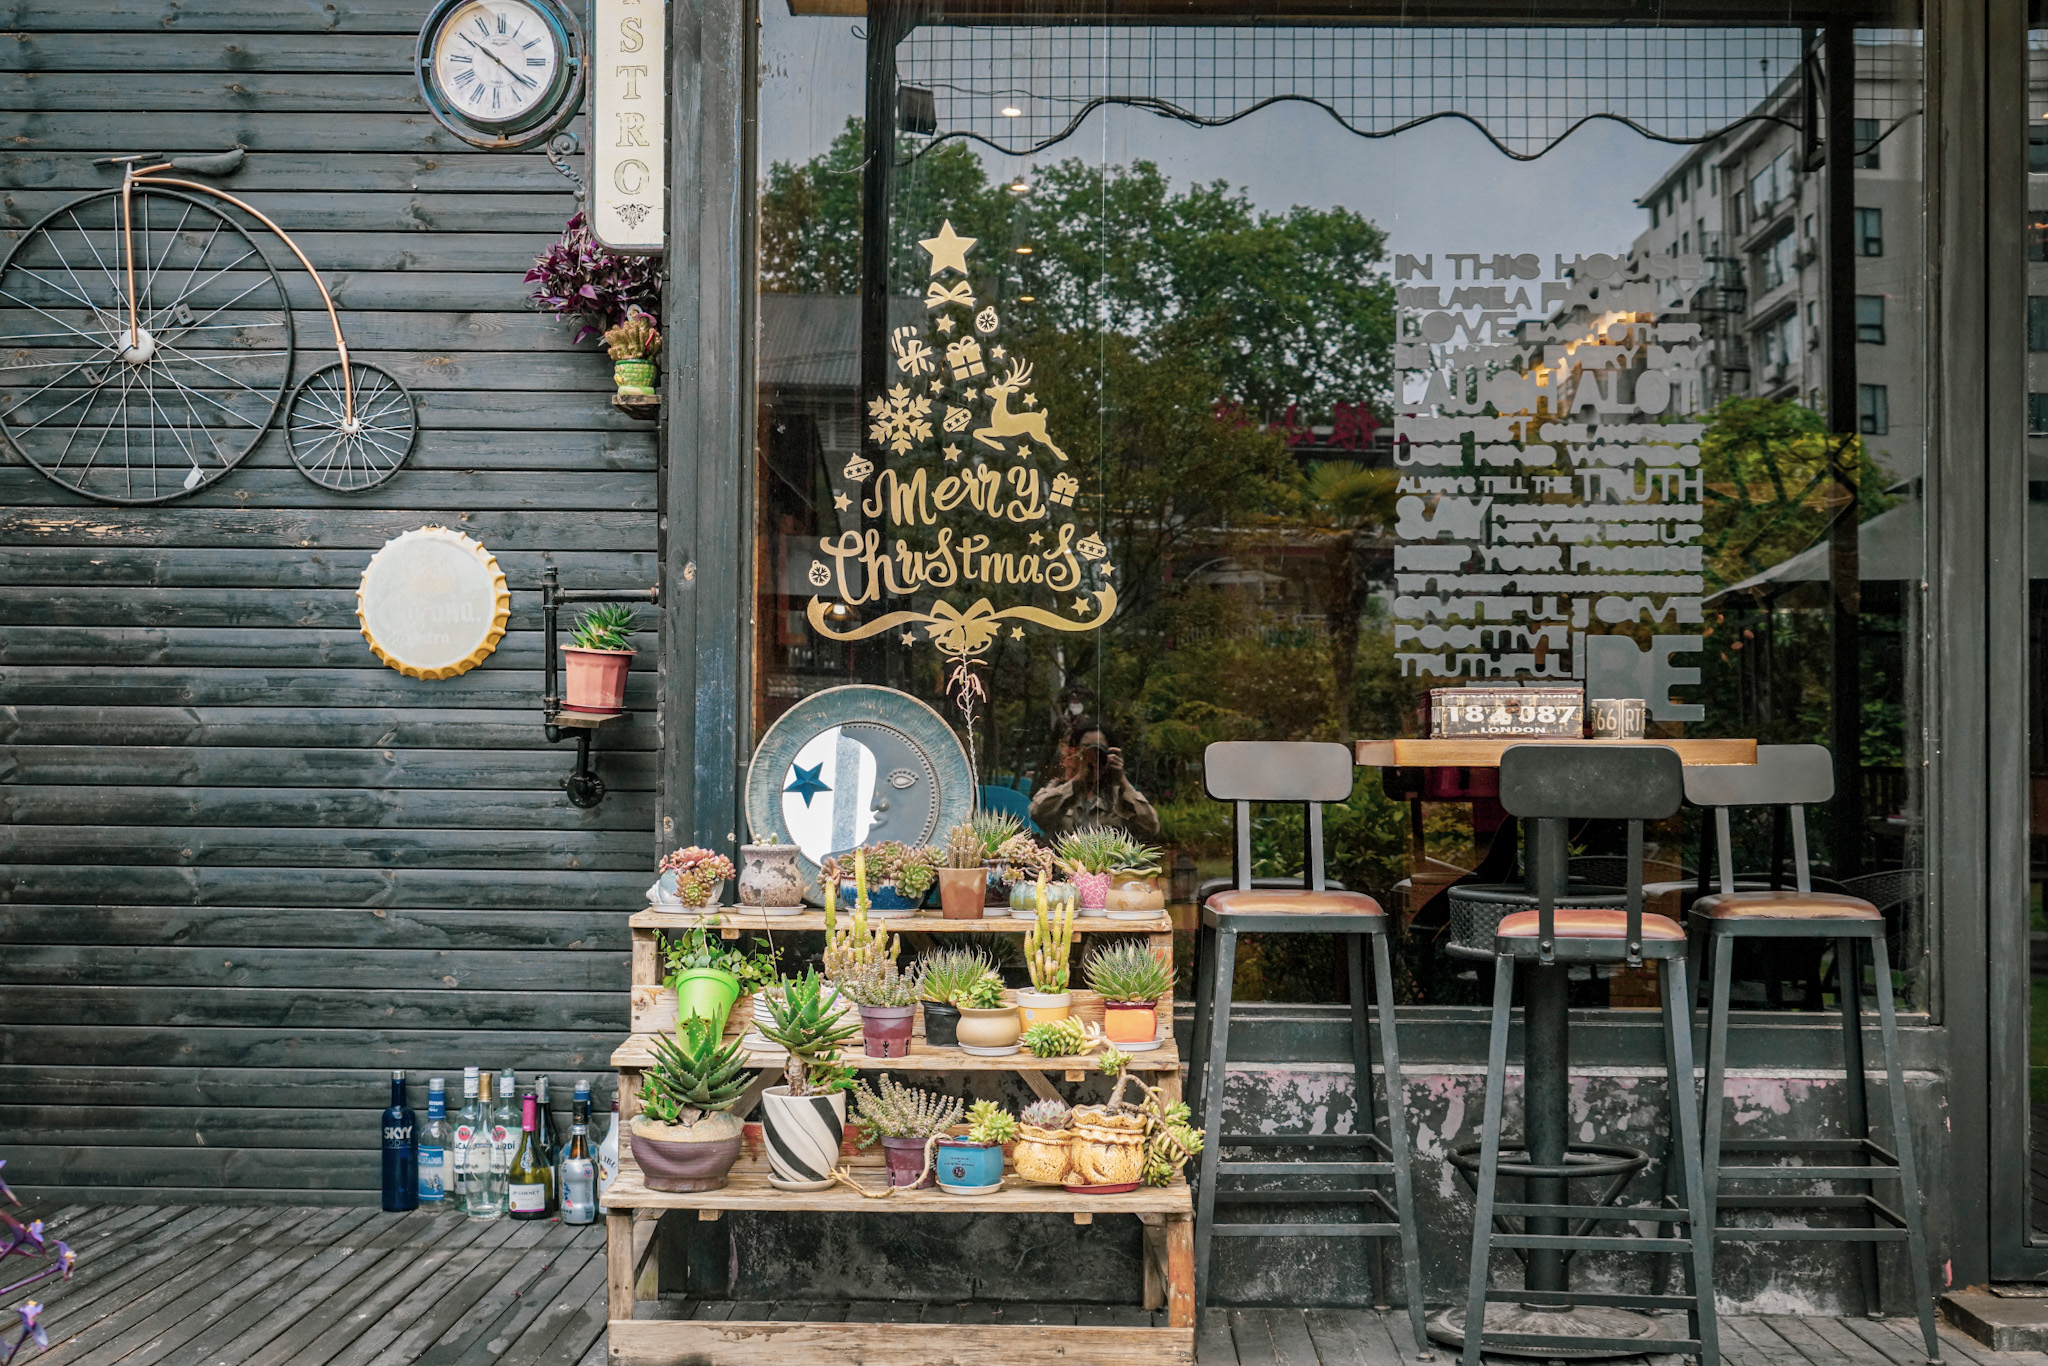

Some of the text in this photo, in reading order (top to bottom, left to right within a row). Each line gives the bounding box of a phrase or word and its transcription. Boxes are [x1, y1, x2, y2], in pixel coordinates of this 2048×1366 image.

[613, 0, 650, 195] STRO
[1395, 253, 1702, 281] IN THIS HOUSE
[1541, 282, 1701, 314] FAMILY
[1396, 311, 1517, 343] LOVE
[1394, 370, 1558, 414] LAUGH
[862, 463, 1046, 526] Merry
[1574, 468, 1704, 501] TRUTH
[819, 523, 1082, 605] Christmas
[1480, 726, 1546, 734] LONDON
[384, 1125, 413, 1140] SKYY
